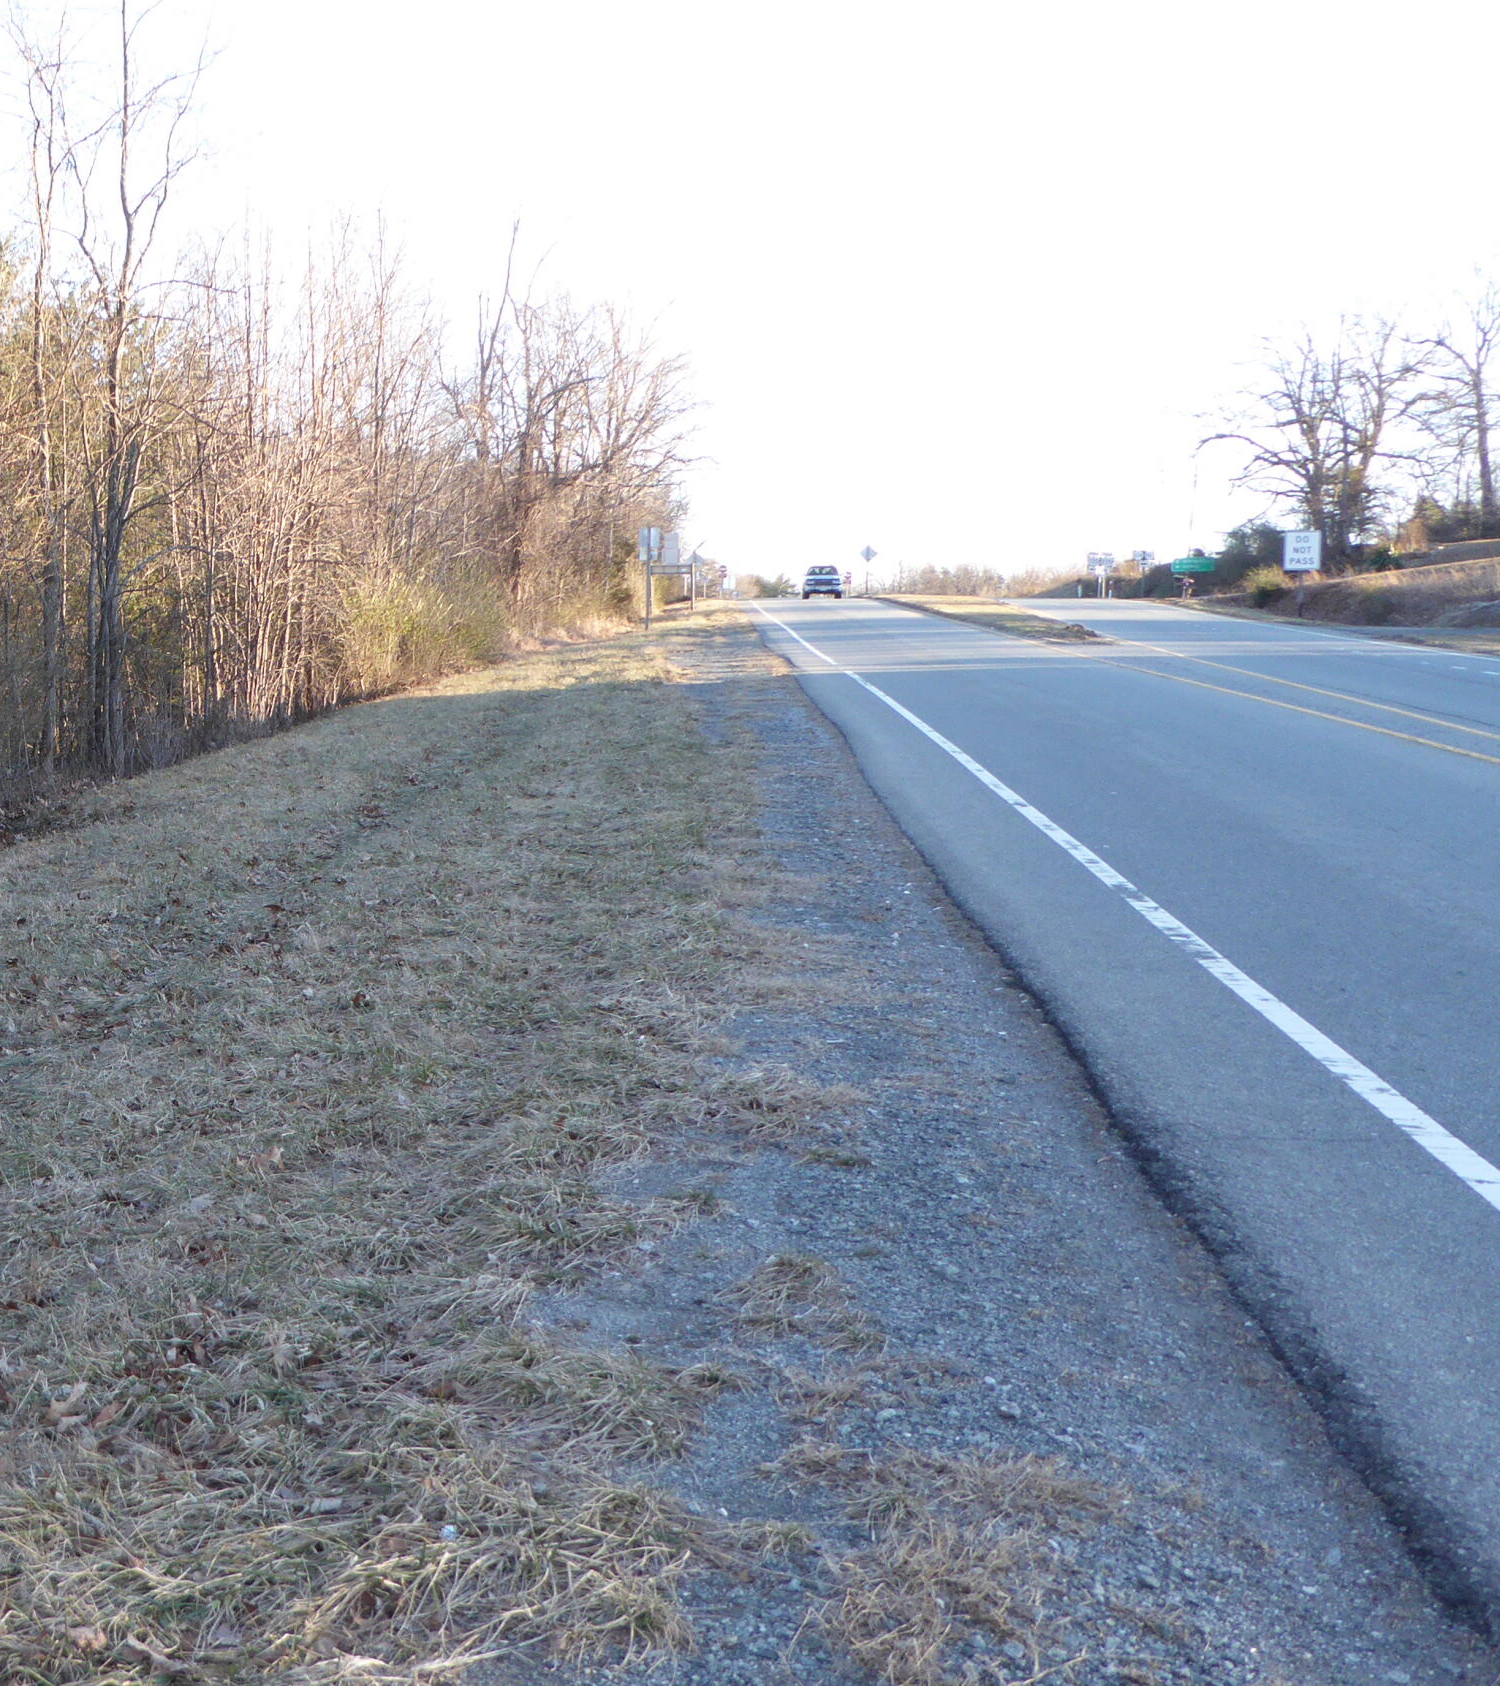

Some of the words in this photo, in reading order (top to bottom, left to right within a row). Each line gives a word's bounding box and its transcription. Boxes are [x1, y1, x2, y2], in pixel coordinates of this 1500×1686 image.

[1295, 535, 1309, 543] DO
[1293, 546, 1311, 554] NOT
[1289, 557, 1316, 565] PASS
